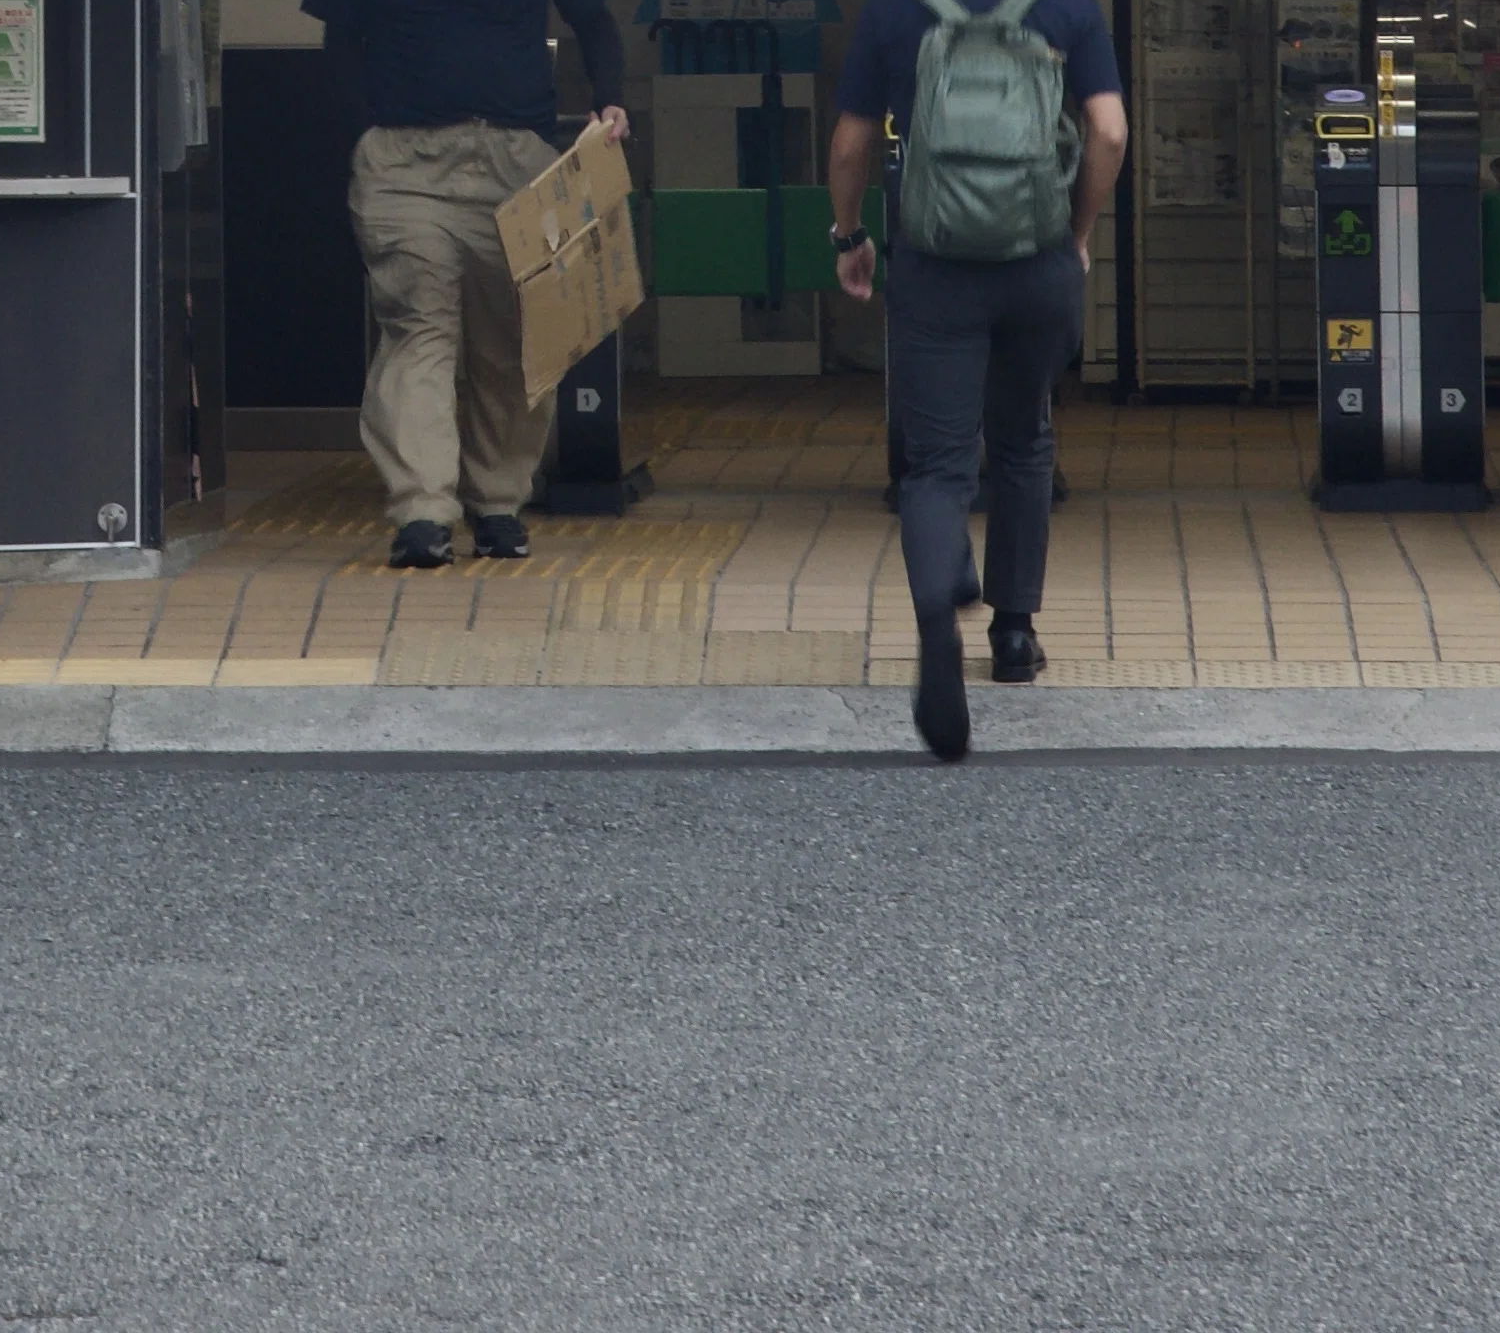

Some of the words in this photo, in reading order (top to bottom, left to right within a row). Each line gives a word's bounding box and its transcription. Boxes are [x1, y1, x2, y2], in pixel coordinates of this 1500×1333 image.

[583, 393, 591, 407] 1
[1346, 393, 1358, 407] 2
[1445, 393, 1458, 407] 3
